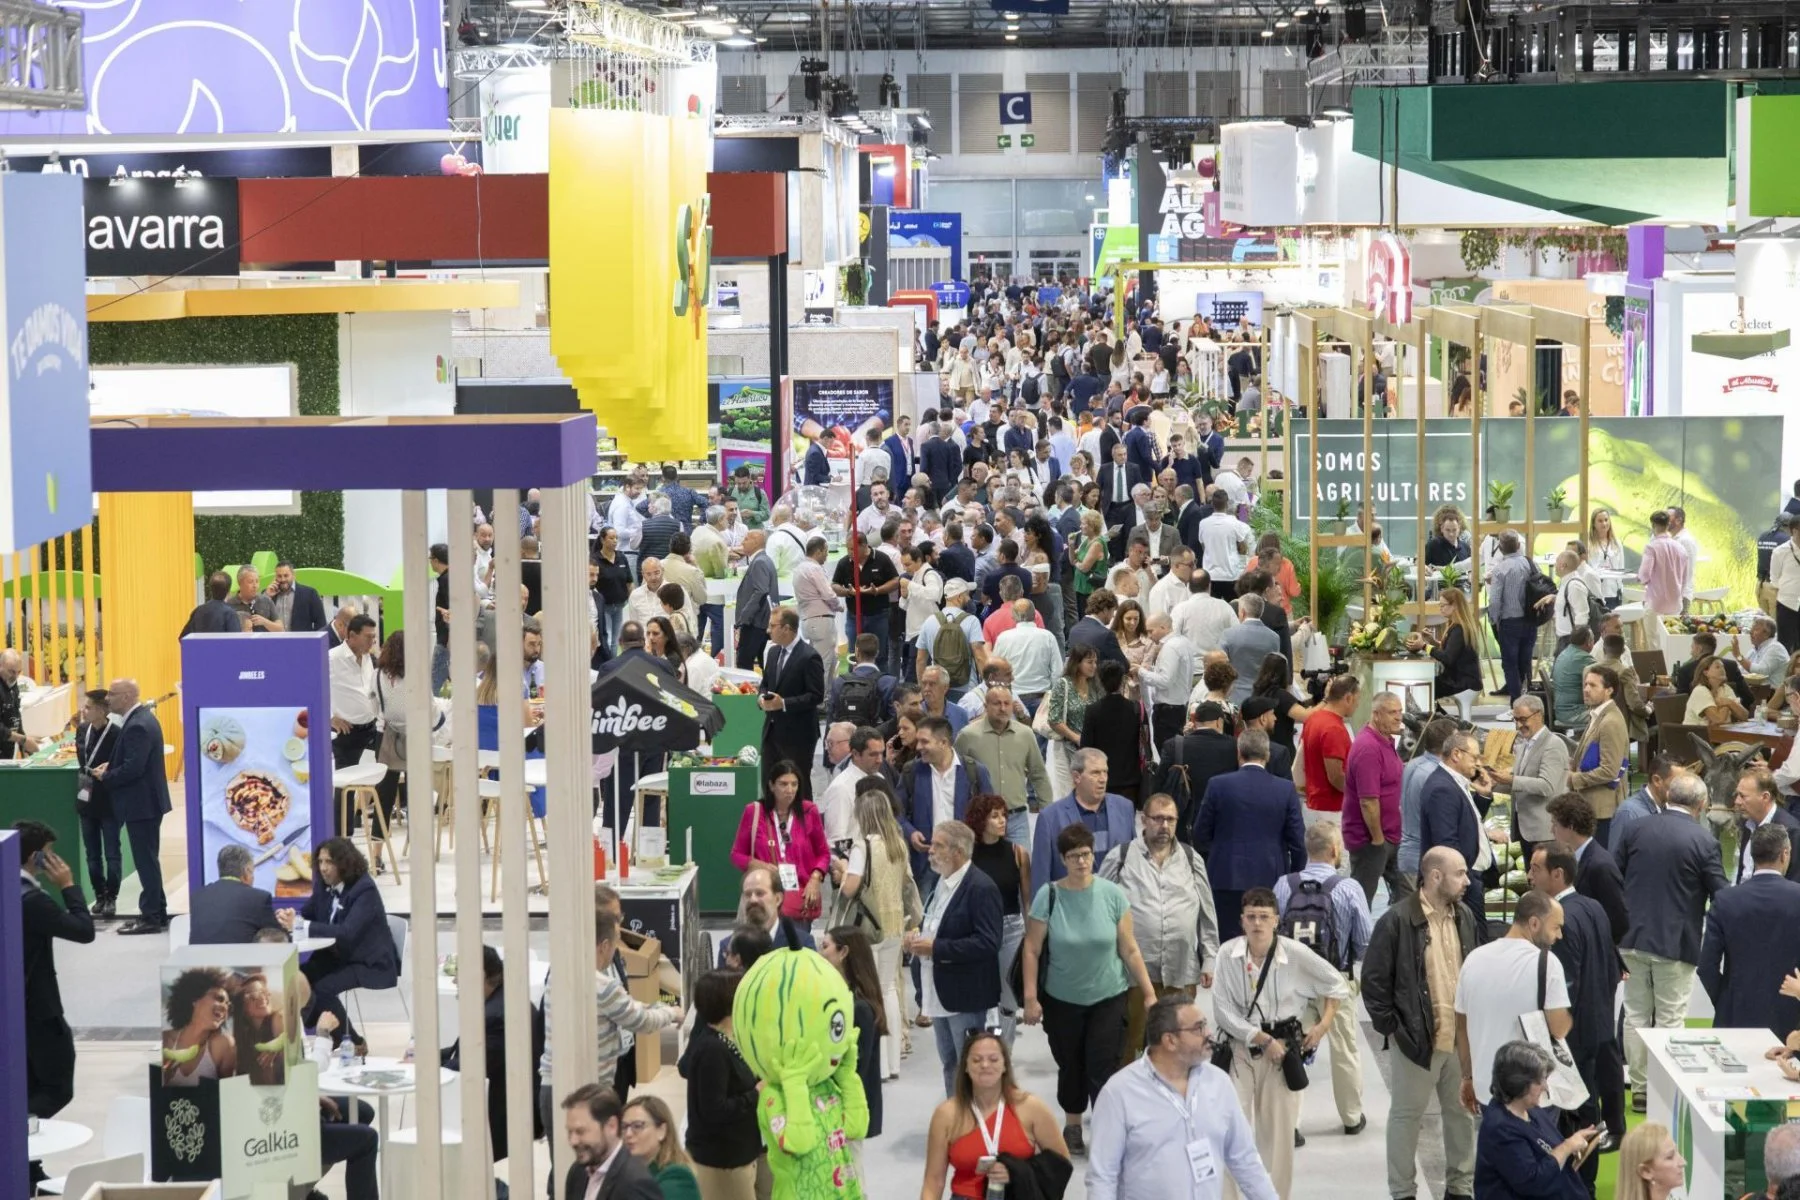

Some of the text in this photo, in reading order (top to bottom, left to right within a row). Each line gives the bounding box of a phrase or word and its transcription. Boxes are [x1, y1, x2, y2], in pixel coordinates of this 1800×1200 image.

[1007, 96, 1025, 120] C
[82, 206, 225, 250] avarra
[244, 1131, 300, 1157] Galkia
